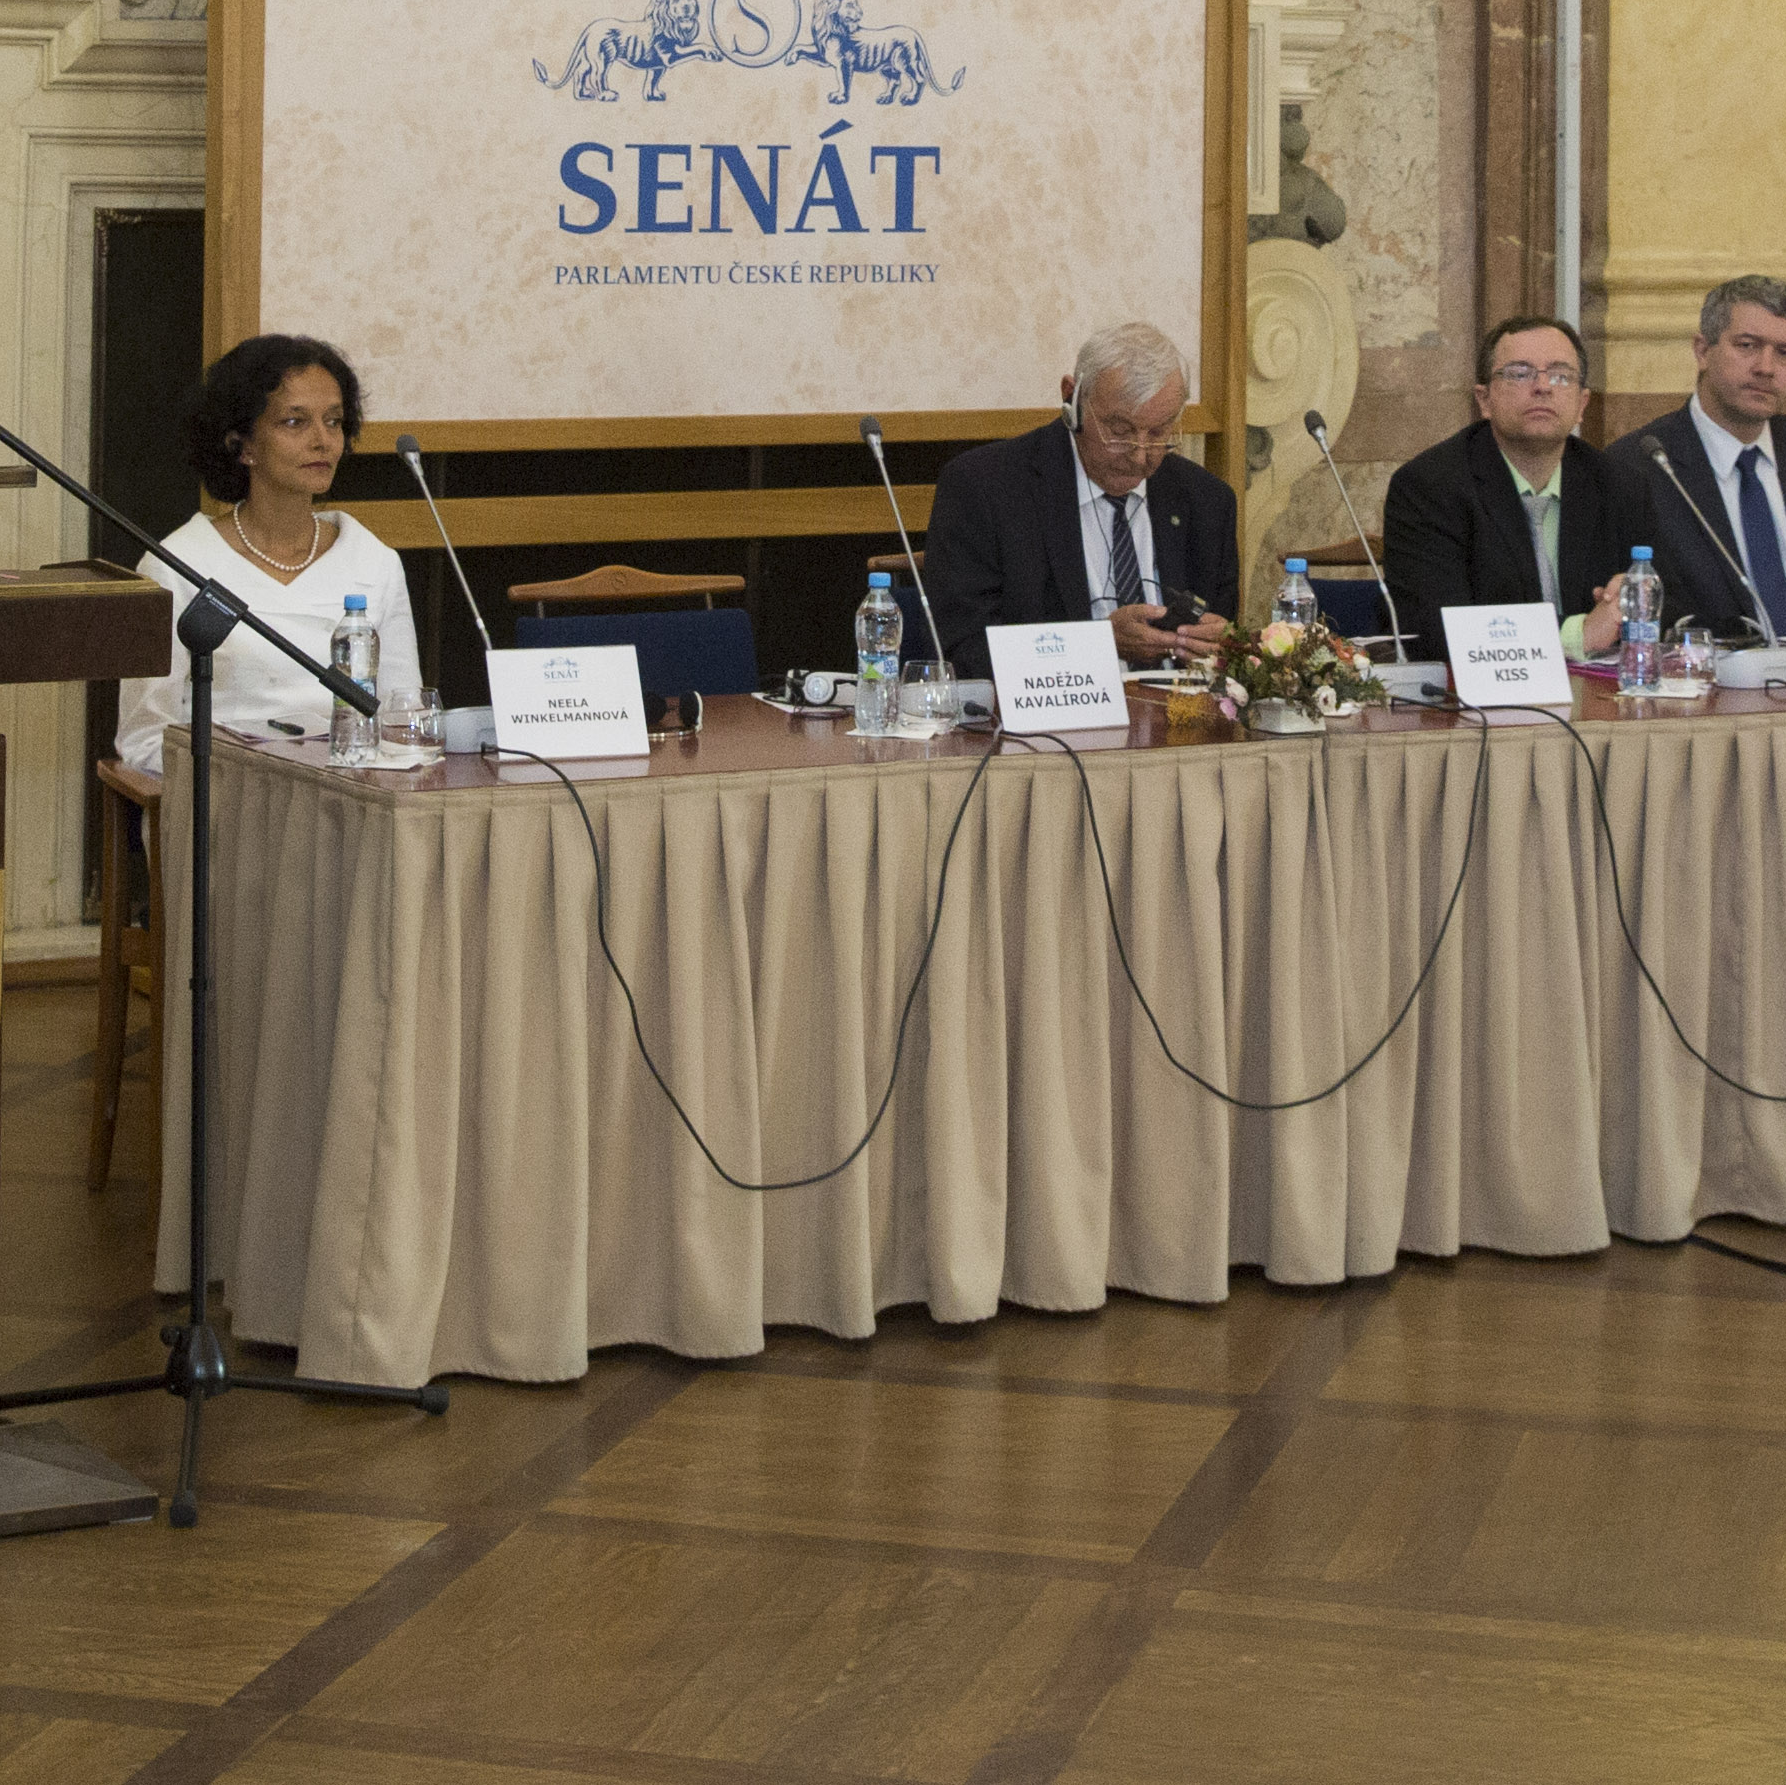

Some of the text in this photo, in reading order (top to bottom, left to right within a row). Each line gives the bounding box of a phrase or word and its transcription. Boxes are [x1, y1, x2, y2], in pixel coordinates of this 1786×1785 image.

[557, 118, 941, 235] SENÁT
[554, 260, 942, 286] PARLAMENTU ČESKÉ REPUBLIKY
[1467, 645, 1547, 662] SÁNDOR M.
[1023, 670, 1094, 689] NADĚŽDA
[1494, 667, 1529, 681] KISS
[547, 697, 588, 708] NEELA
[1014, 687, 1111, 709] KAVALÍROVÁ
[510, 706, 628, 723] WINKELMANNOVÁ
